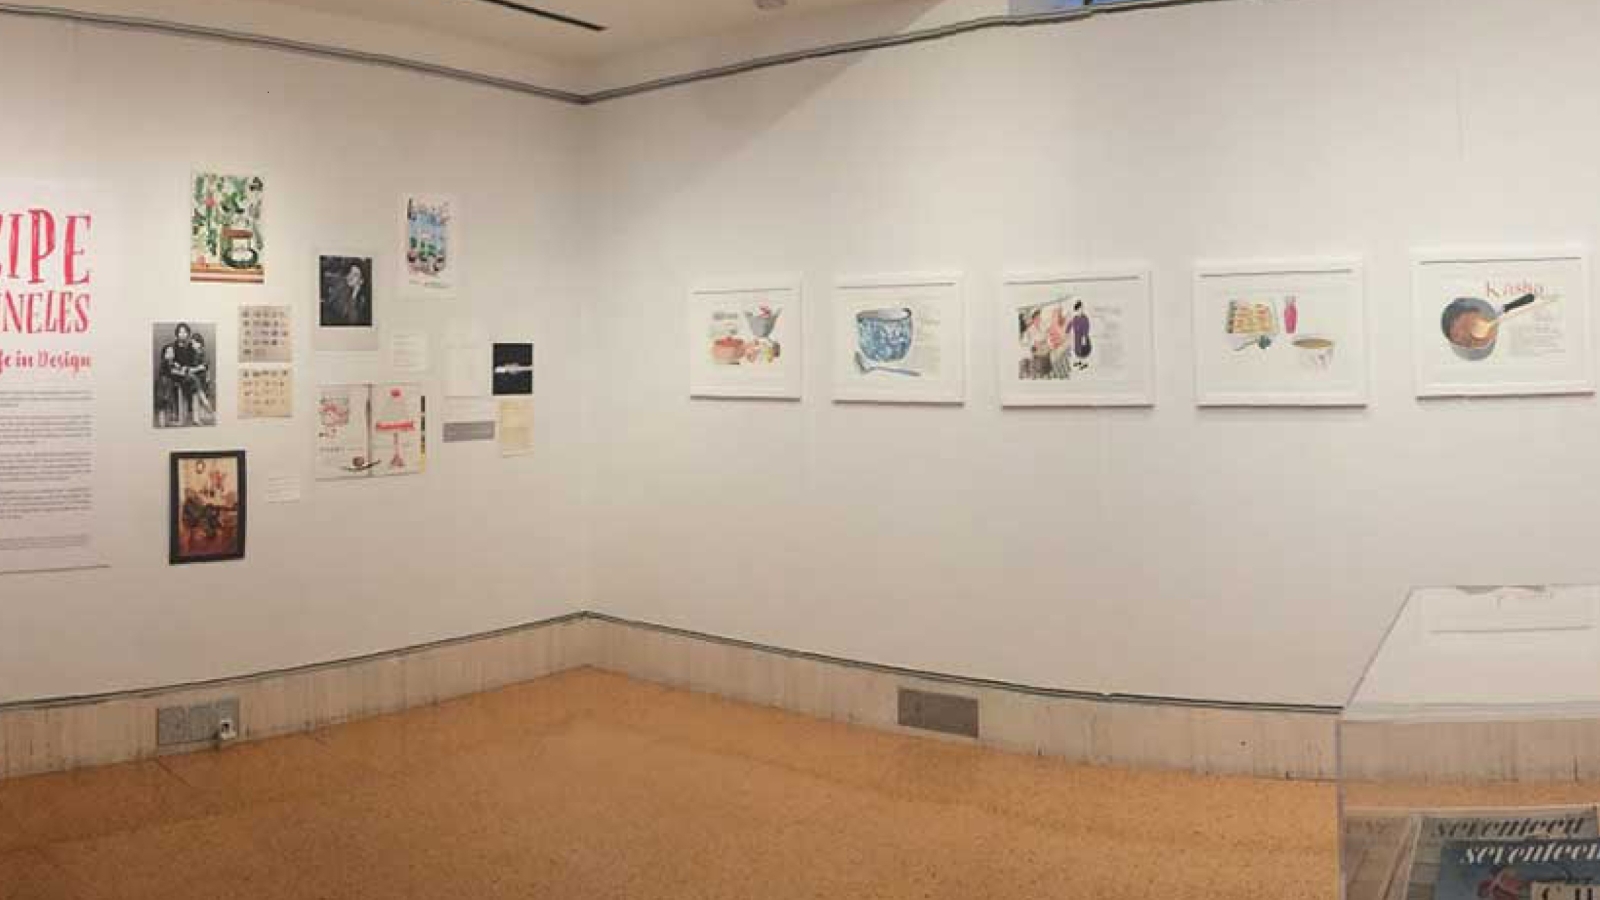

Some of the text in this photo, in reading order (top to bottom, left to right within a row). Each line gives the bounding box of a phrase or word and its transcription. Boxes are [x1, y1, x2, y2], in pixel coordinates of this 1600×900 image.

[0, 208, 91, 284] IPE
[0, 289, 91, 334] NELES
[16, 350, 33, 368] in
[37, 349, 92, 374] Design
